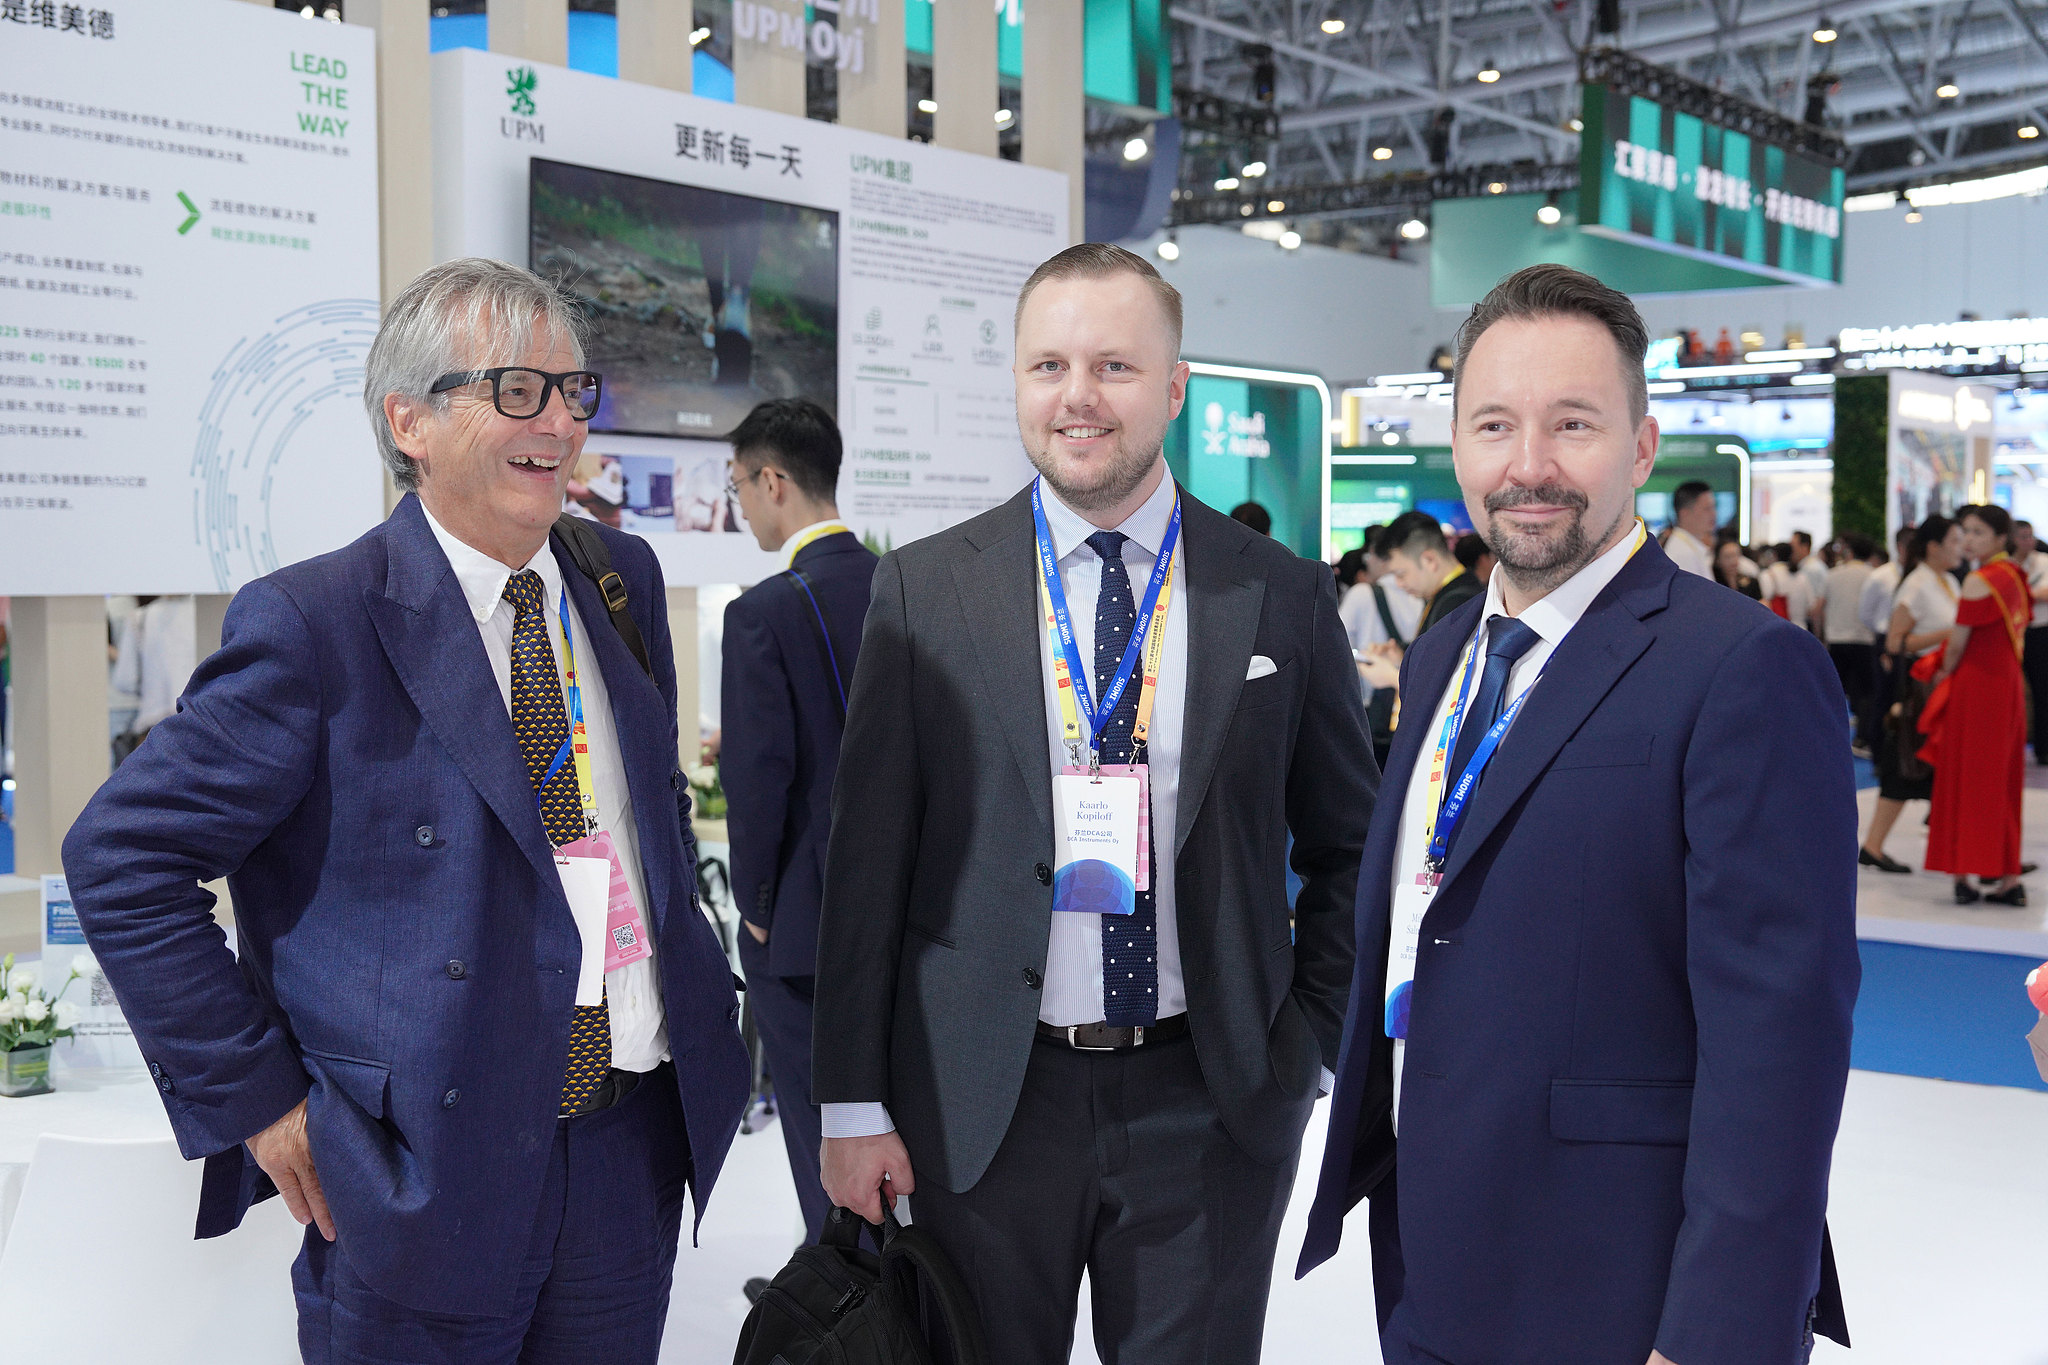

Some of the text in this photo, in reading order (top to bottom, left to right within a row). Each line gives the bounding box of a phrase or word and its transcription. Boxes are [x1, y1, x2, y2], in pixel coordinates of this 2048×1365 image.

[732, 0, 804, 51] UPM
[811, 20, 864, 74] Oyj
[290, 51, 348, 79] LEAD
[300, 82, 348, 109] THE
[297, 112, 348, 138] WAY
[501, 117, 546, 144] UPM
[674, 122, 802, 180] 更新每一天
[1454, 774, 1473, 801] SUOMI
[1076, 812, 1113, 822] Kopiloff
[1079, 800, 1108, 810] Kaarlo
